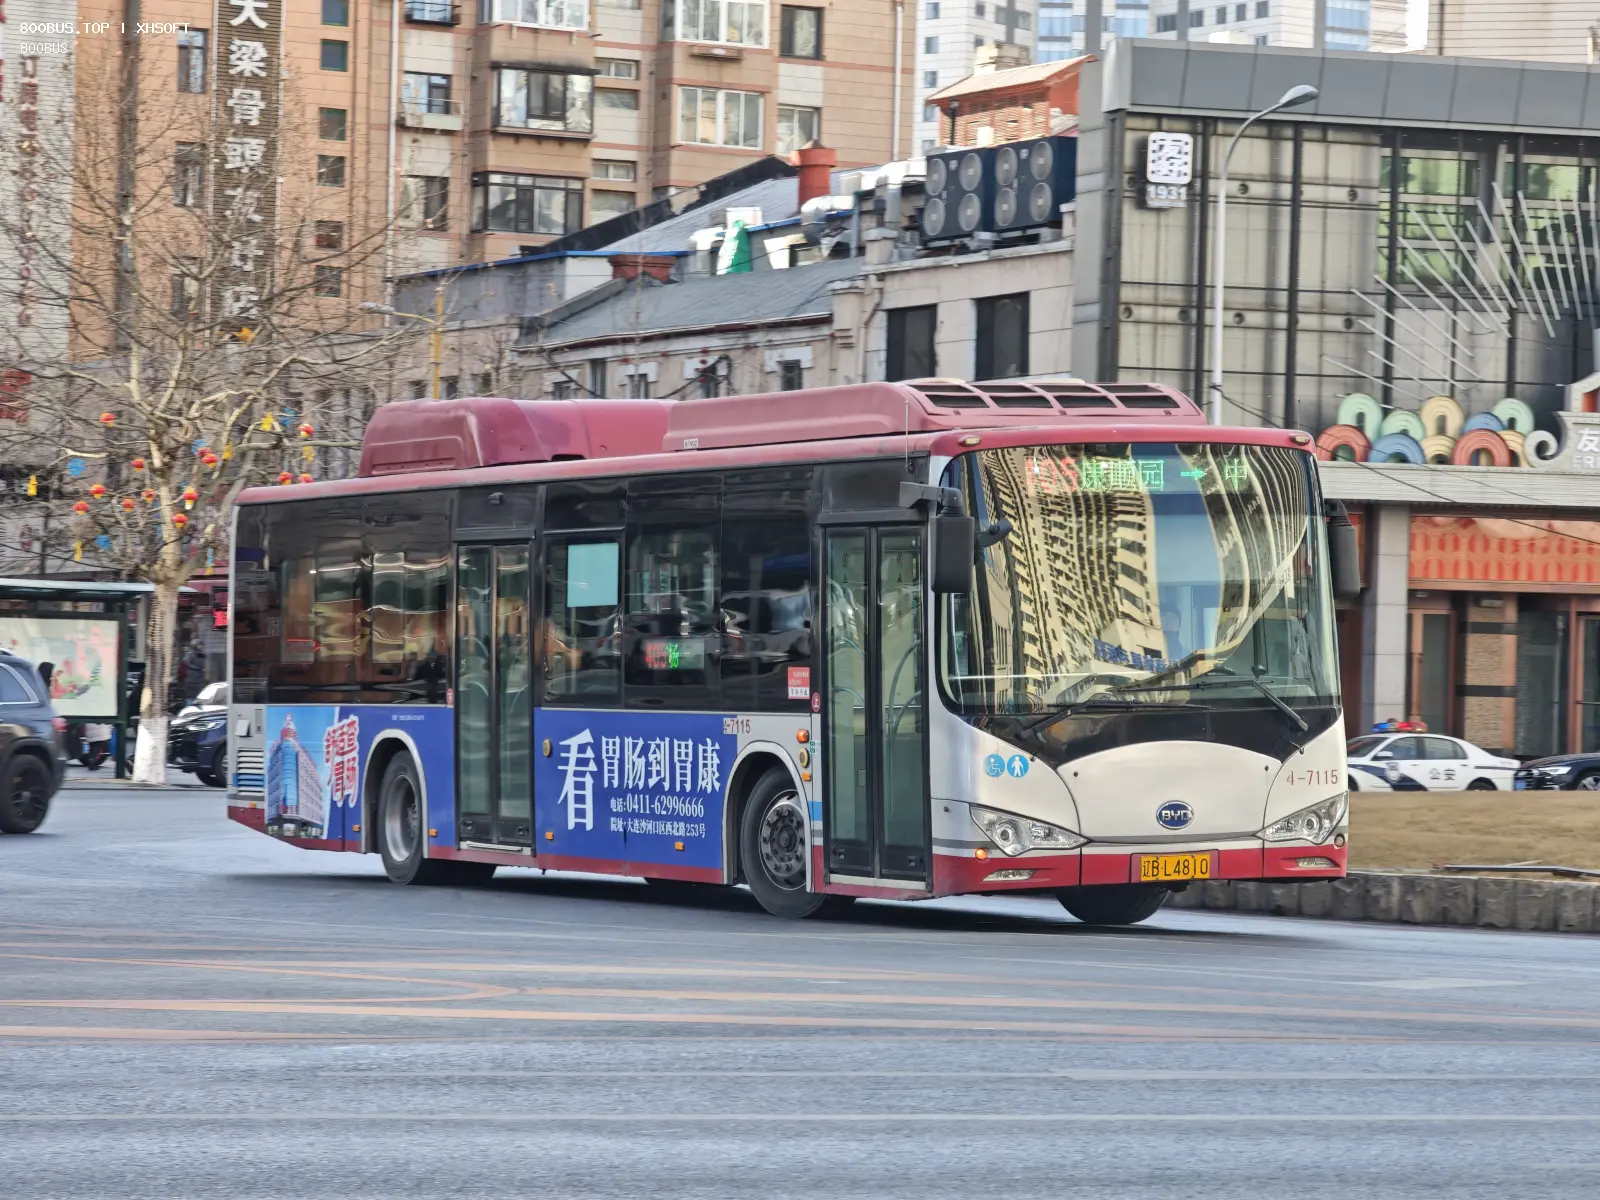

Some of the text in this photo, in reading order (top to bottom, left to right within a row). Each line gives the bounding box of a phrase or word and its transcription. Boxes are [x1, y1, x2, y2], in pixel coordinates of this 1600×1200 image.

[1147, 185, 1187, 200] 1931
[1577, 428, 1600, 453] 友
[557, 728, 721, 831] 看 胃肠到胃康
[1286, 769, 1339, 786] 4-7115
[1428, 768, 1457, 782] 公安
[1161, 809, 1193, 821] BYD
